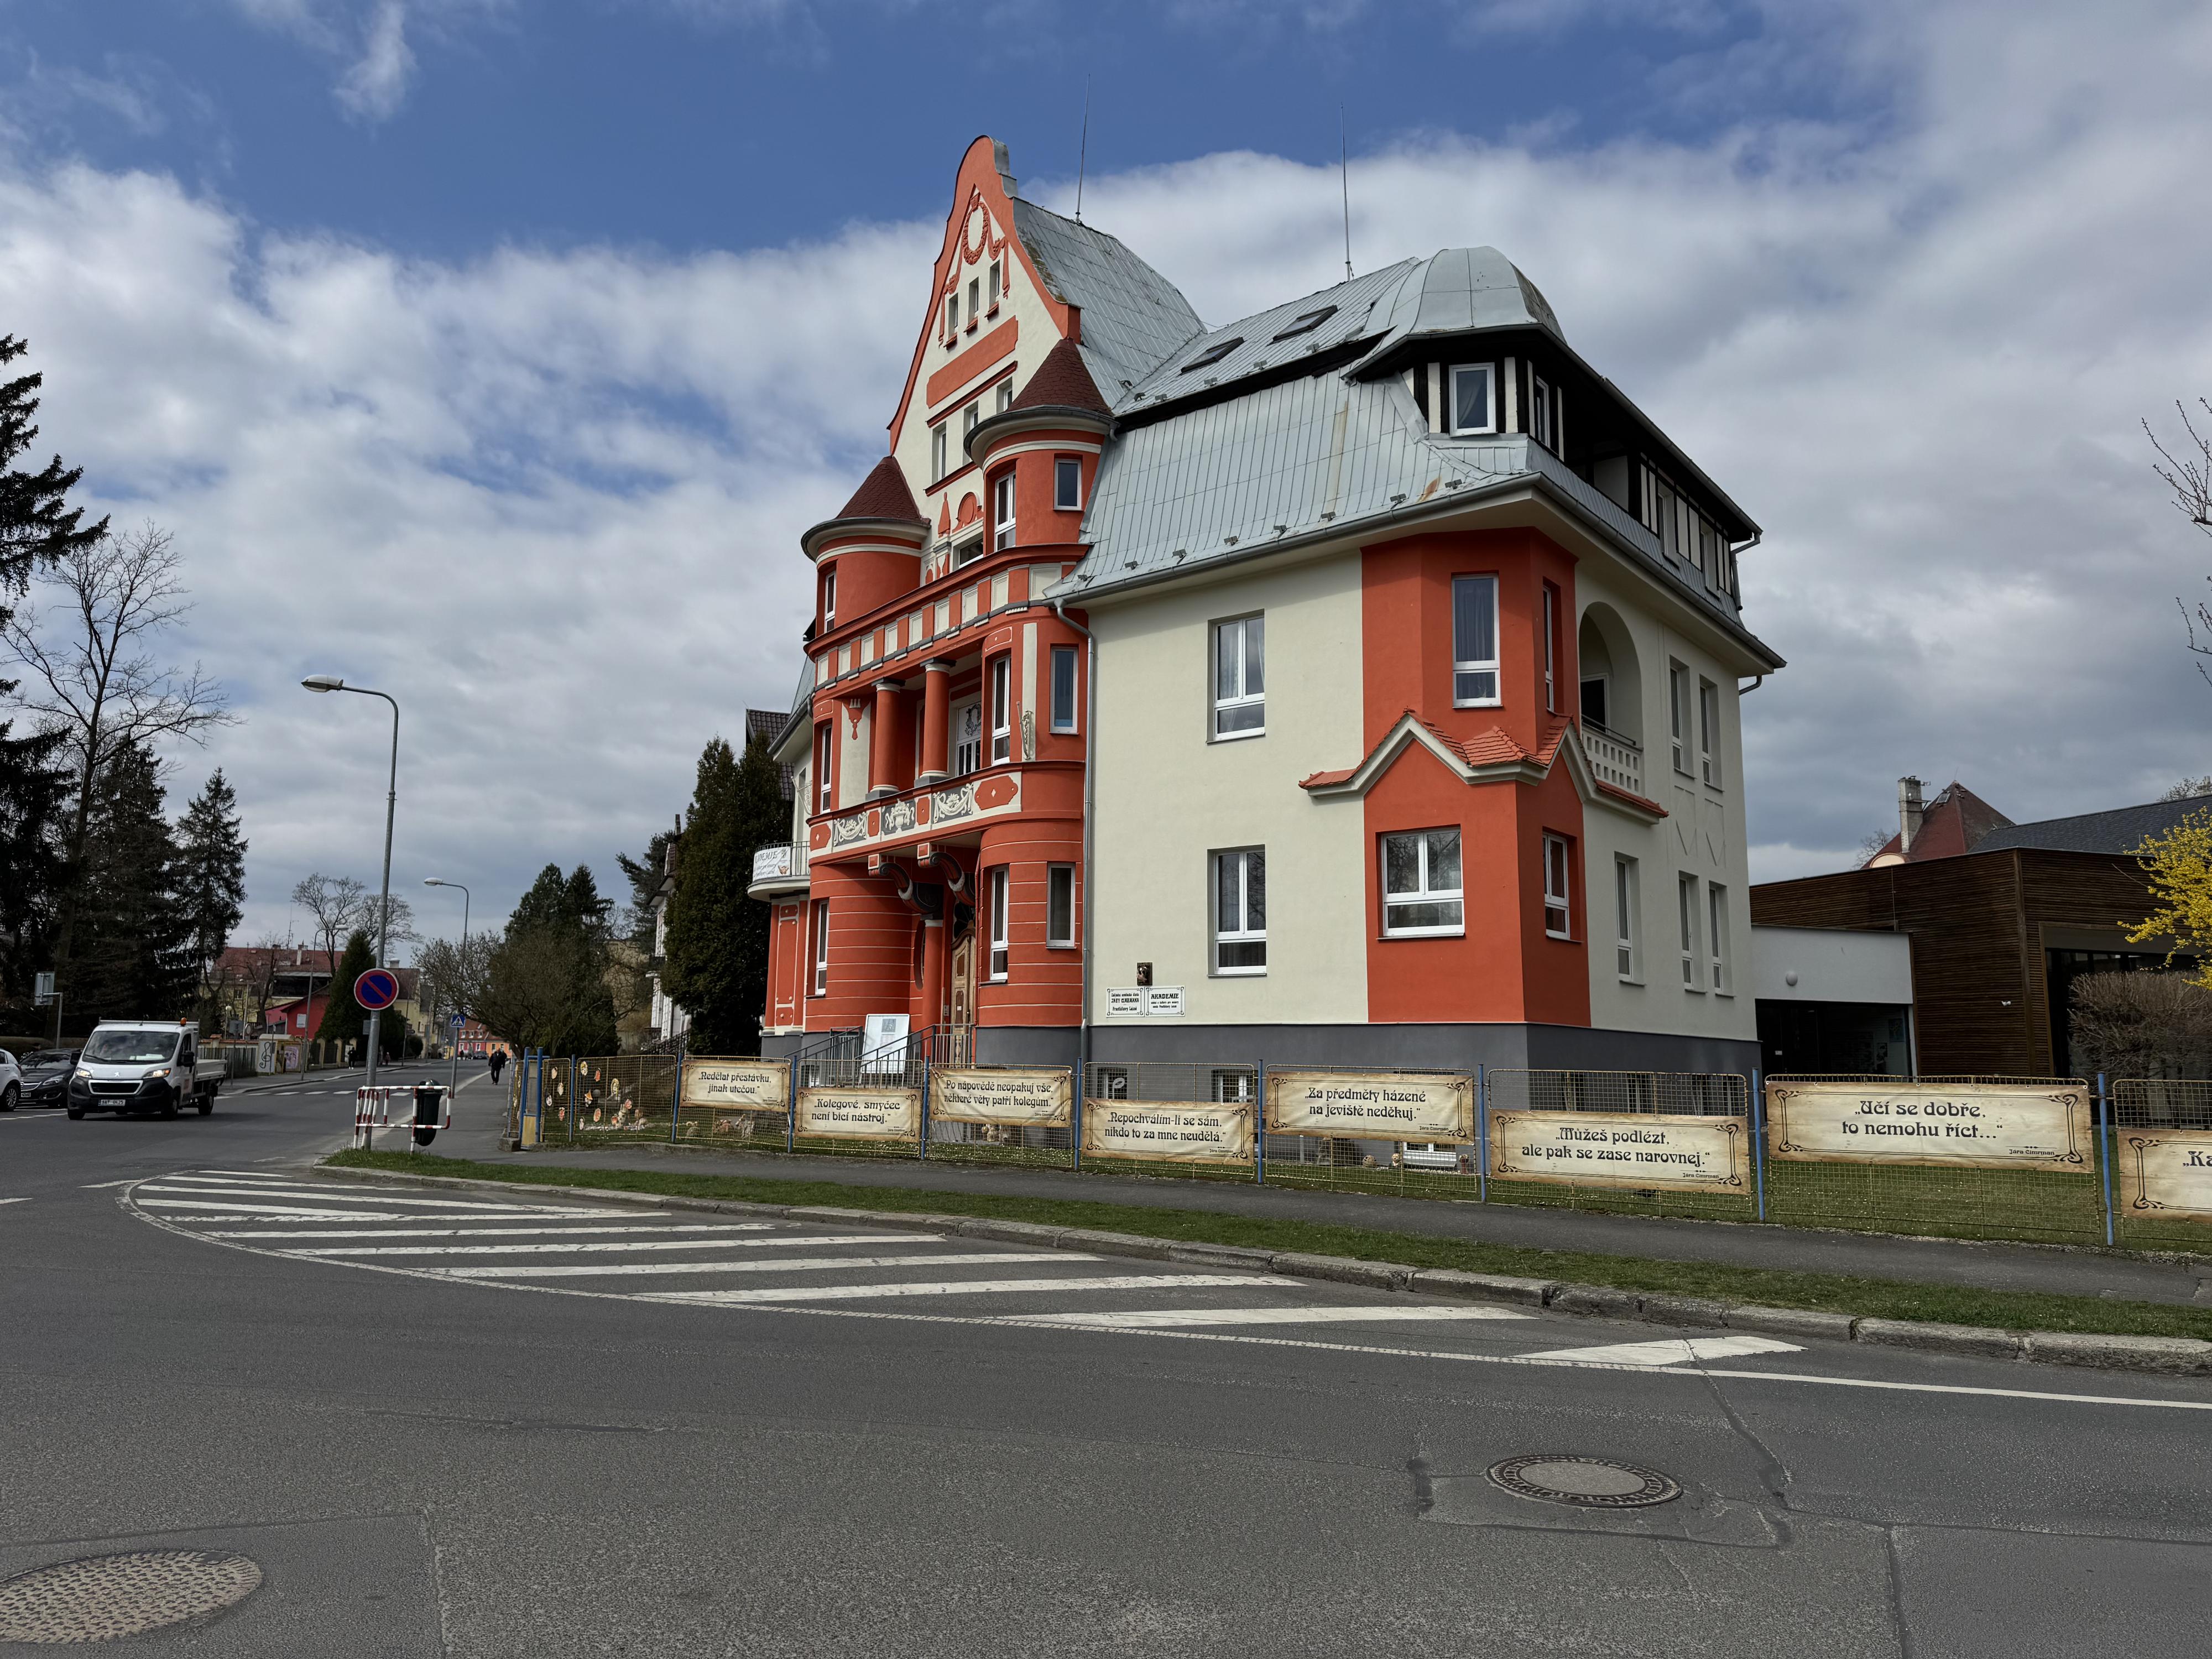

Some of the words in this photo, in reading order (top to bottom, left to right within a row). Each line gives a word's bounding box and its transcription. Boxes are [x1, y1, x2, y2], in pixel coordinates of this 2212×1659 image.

[731, 1073, 771, 1083] přestávku,
[708, 1084, 728, 1093] jinak
[958, 1081, 995, 1092] nápovědě
[997, 1082, 1034, 1094] neopakuj
[1036, 1083, 1053, 1093] vše,
[944, 1093, 972, 1103] některé
[974, 1095, 990, 1106] věty
[993, 1096, 1011, 1107] patří
[1305, 1087, 1323, 1099] „Za
[1327, 1088, 1379, 1103] předměty
[1383, 1090, 1426, 1102] házené
[864, 1101, 900, 1111] smyčec
[1310, 1107, 1323, 1115] na
[1325, 1104, 1363, 1118] jeviště
[1367, 1107, 1421, 1121] neděkuj.“
[1855, 1101, 1890, 1115] „Učí
[1896, 1105, 1918, 1116] se
[1924, 1102, 1986, 1118] dobře,
[812, 1112, 830, 1120] není
[833, 1112, 849, 1121] bicí
[1198, 1116, 1222, 1127] sám,
[1105, 1127, 1130, 1138] nikdo
[1133, 1129, 1141, 1138] to
[1144, 1131, 1155, 1139] za
[1158, 1132, 1178, 1140] mne
[1181, 1131, 1226, 1142] neudělá.“
[1843, 1121, 1859, 1134] to
[1865, 1122, 1939, 1136] nemohu
[1556, 1127, 1608, 1141] „Můžeš
[1612, 1130, 1670, 1145] podlézt,
[1522, 1144, 1542, 1156] ale
[1546, 1146, 1573, 1160] pak
[1577, 1149, 1593, 1159] se
[1597, 1150, 1631, 1161] zase
[1636, 1152, 1710, 1168] narovnej.“
